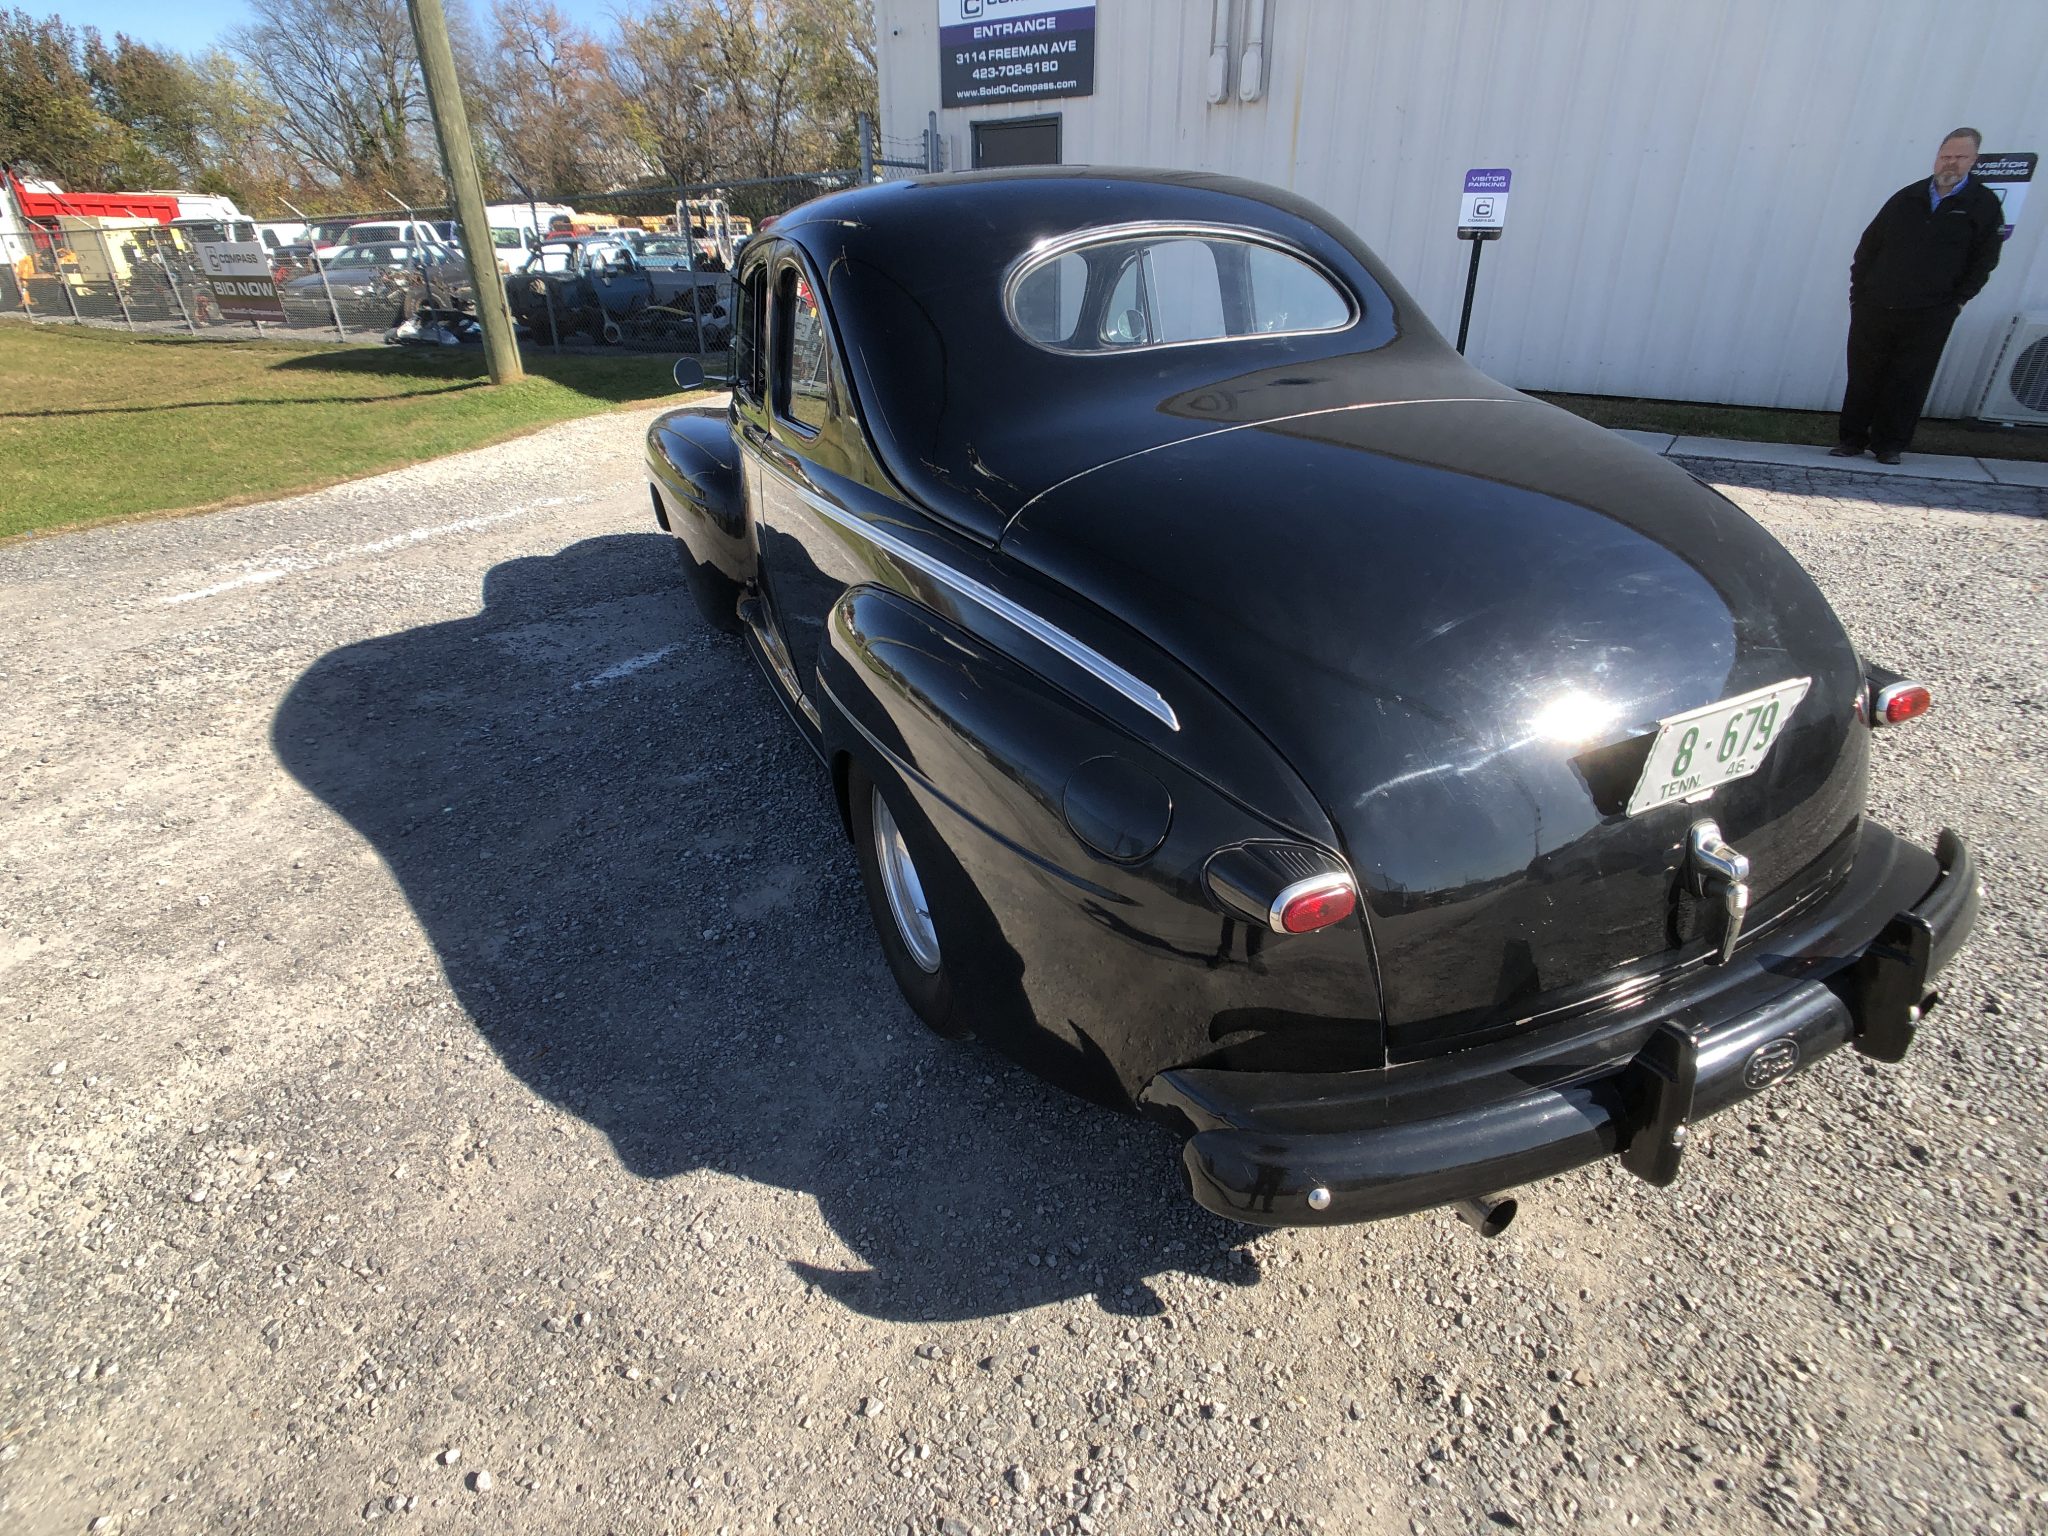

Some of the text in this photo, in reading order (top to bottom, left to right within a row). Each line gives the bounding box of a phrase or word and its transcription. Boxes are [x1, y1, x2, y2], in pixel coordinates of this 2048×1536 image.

[973, 17, 1056, 39] ENTRANCE
[956, 40, 1077, 64] 3114 FREEMAN AVE
[972, 60, 1058, 79] 423-702-6180
[1977, 161, 2029, 169] VISITOR
[218, 253, 258, 264] COMPASS
[212, 281, 275, 297] BID NOW
